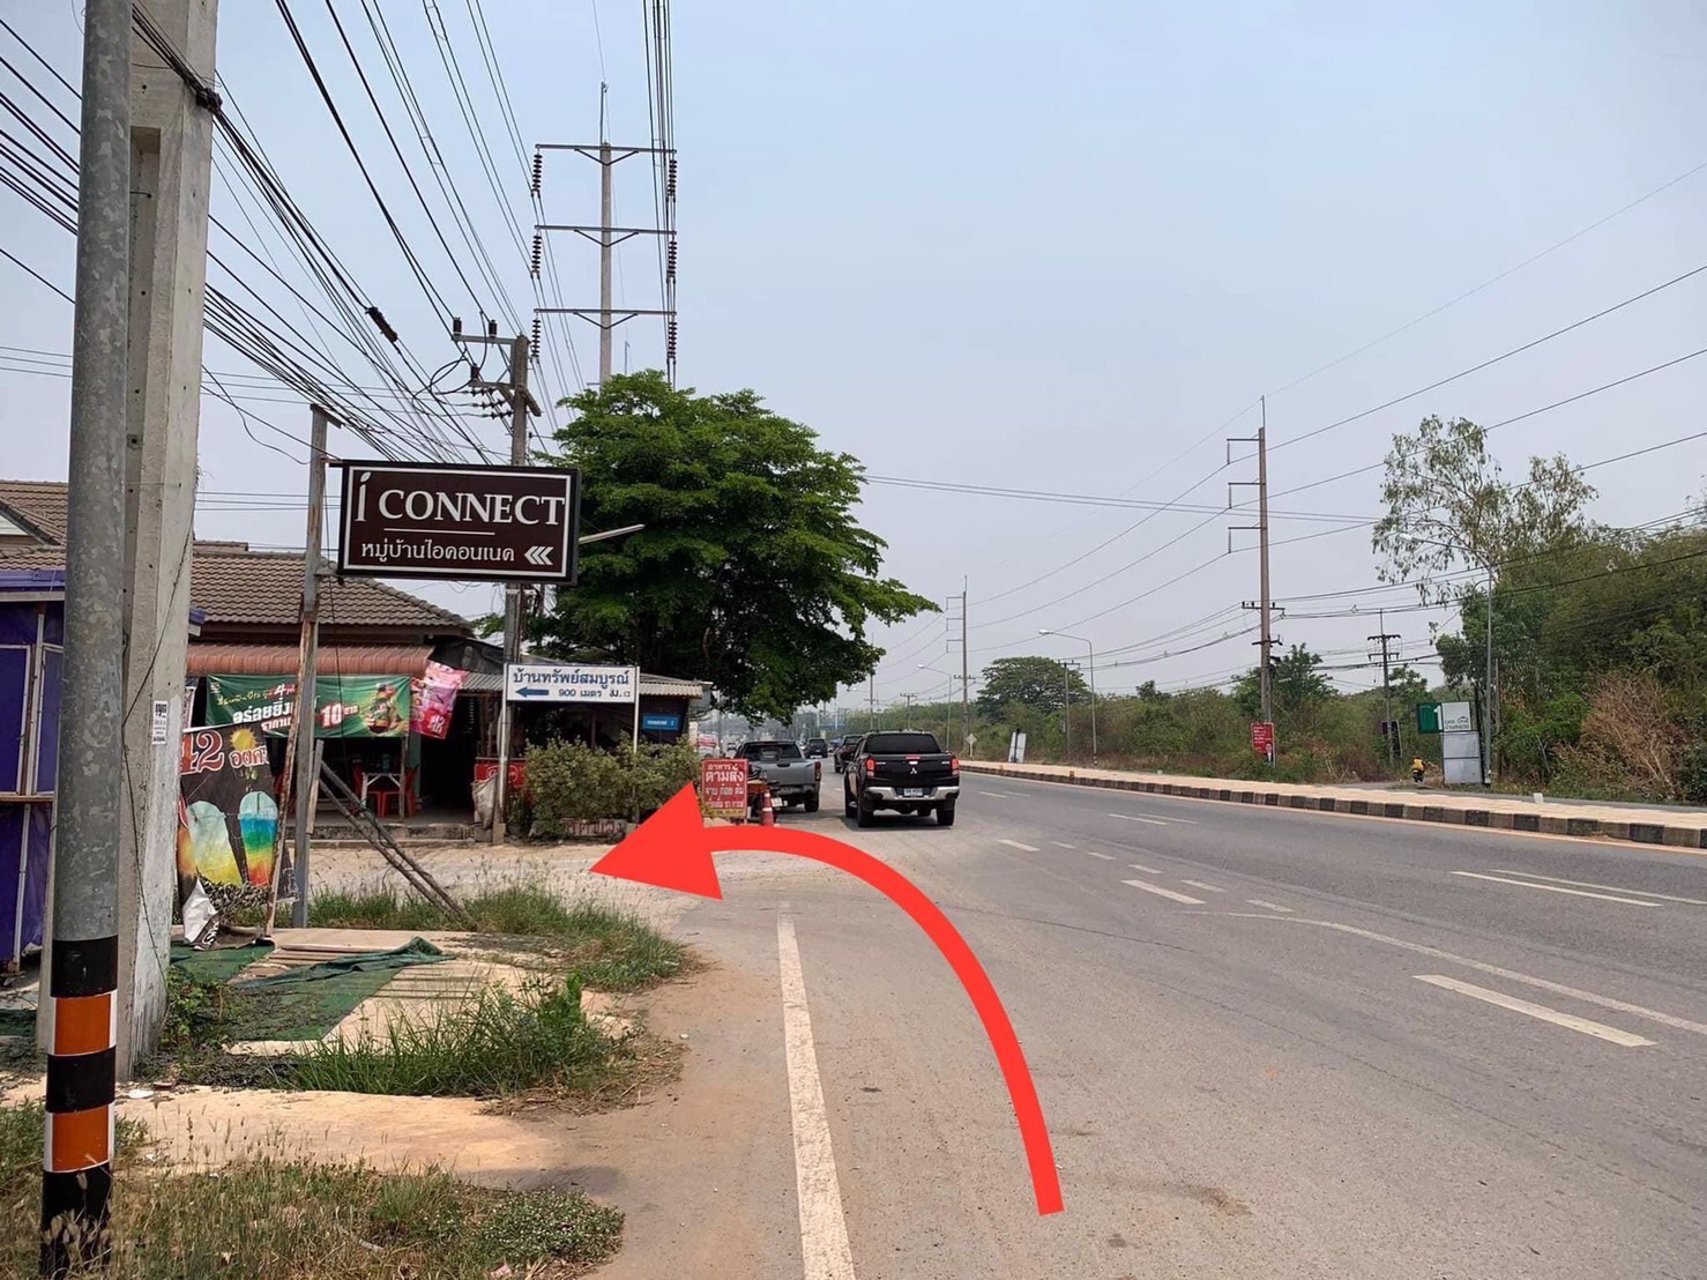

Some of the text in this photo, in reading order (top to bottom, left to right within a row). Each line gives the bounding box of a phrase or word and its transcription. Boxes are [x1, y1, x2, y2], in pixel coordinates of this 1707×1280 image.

[378, 489, 566, 526] CONNECT
[361, 538, 515, 562] หมู่บ้านไอคอนเนค
[513, 667, 630, 690] บ้านทรัพย์สมบูรณ์
[558, 689, 576, 697] 900
[580, 689, 602, 698] เมตร
[320, 703, 342, 728] 10
